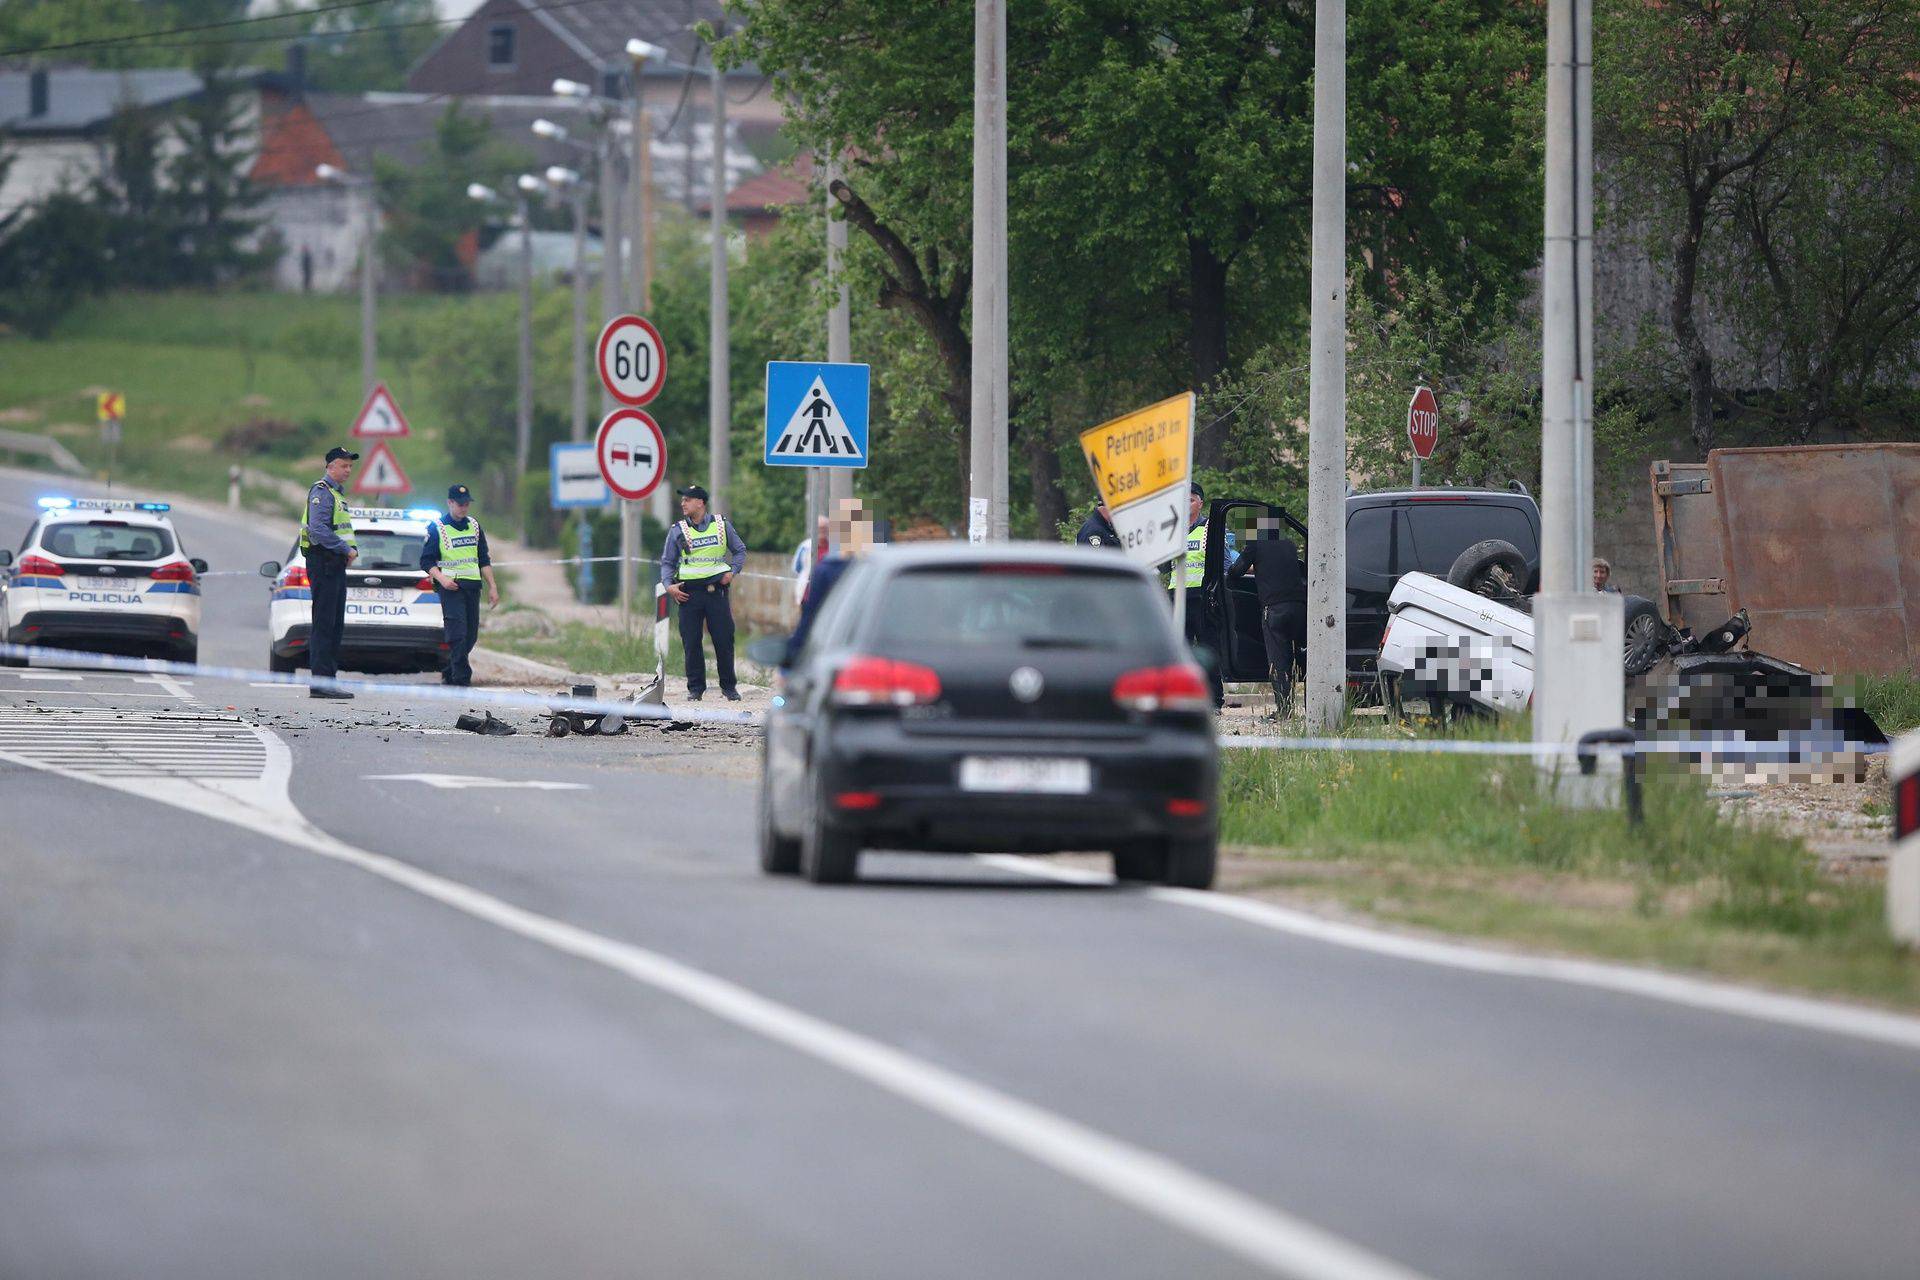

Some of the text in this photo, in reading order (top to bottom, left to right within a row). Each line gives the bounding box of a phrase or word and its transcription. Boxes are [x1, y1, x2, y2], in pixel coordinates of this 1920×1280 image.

[615, 340, 650, 382] 60
[1411, 409, 1437, 437] STOP
[1106, 423, 1155, 460] Petrinja
[1107, 464, 1140, 496] Sisak
[78, 500, 132, 509] POLICIJA
[69, 592, 143, 603] POLICIJA
[346, 604, 410, 616] OLICIJA
